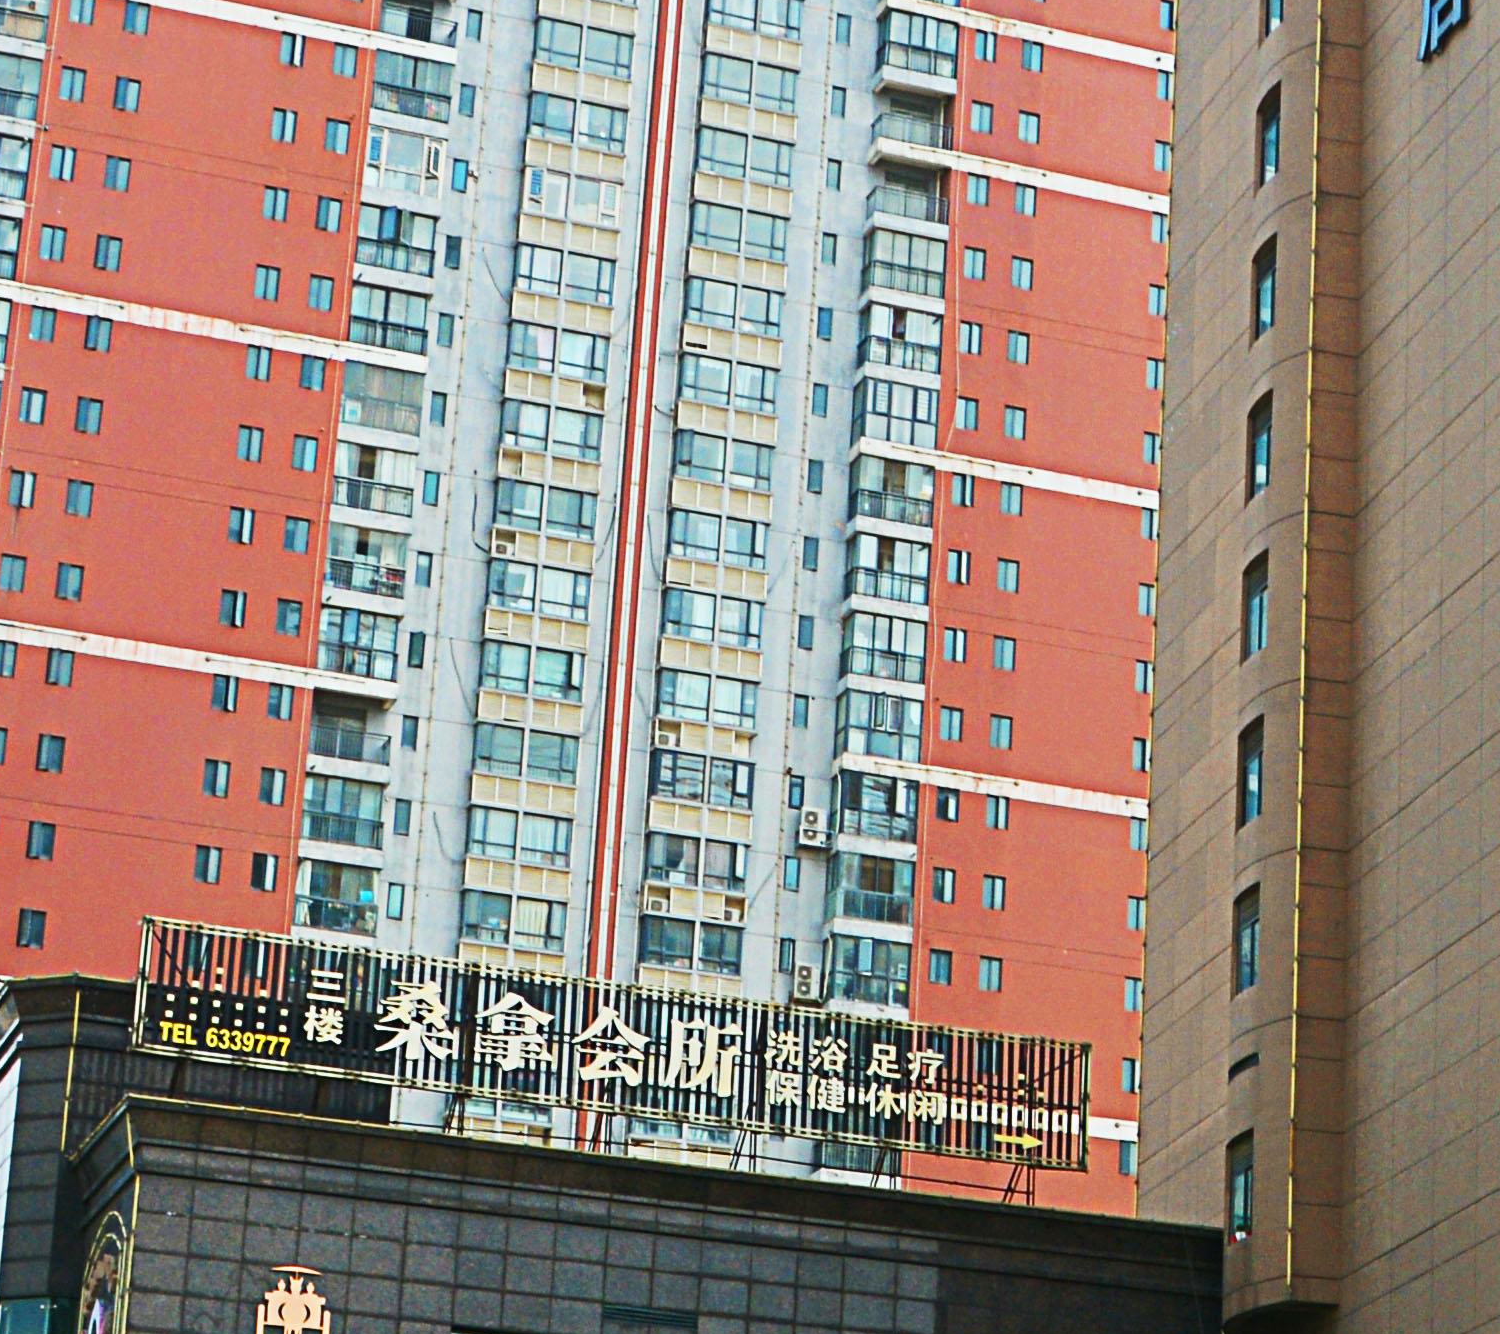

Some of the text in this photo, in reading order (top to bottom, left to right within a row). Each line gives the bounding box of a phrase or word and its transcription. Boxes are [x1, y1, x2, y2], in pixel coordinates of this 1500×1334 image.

[160, 1021, 291, 1057] TEL 6339777
[304, 968, 347, 1045] 三楼
[374, 979, 743, 1099] 桑拿会所
